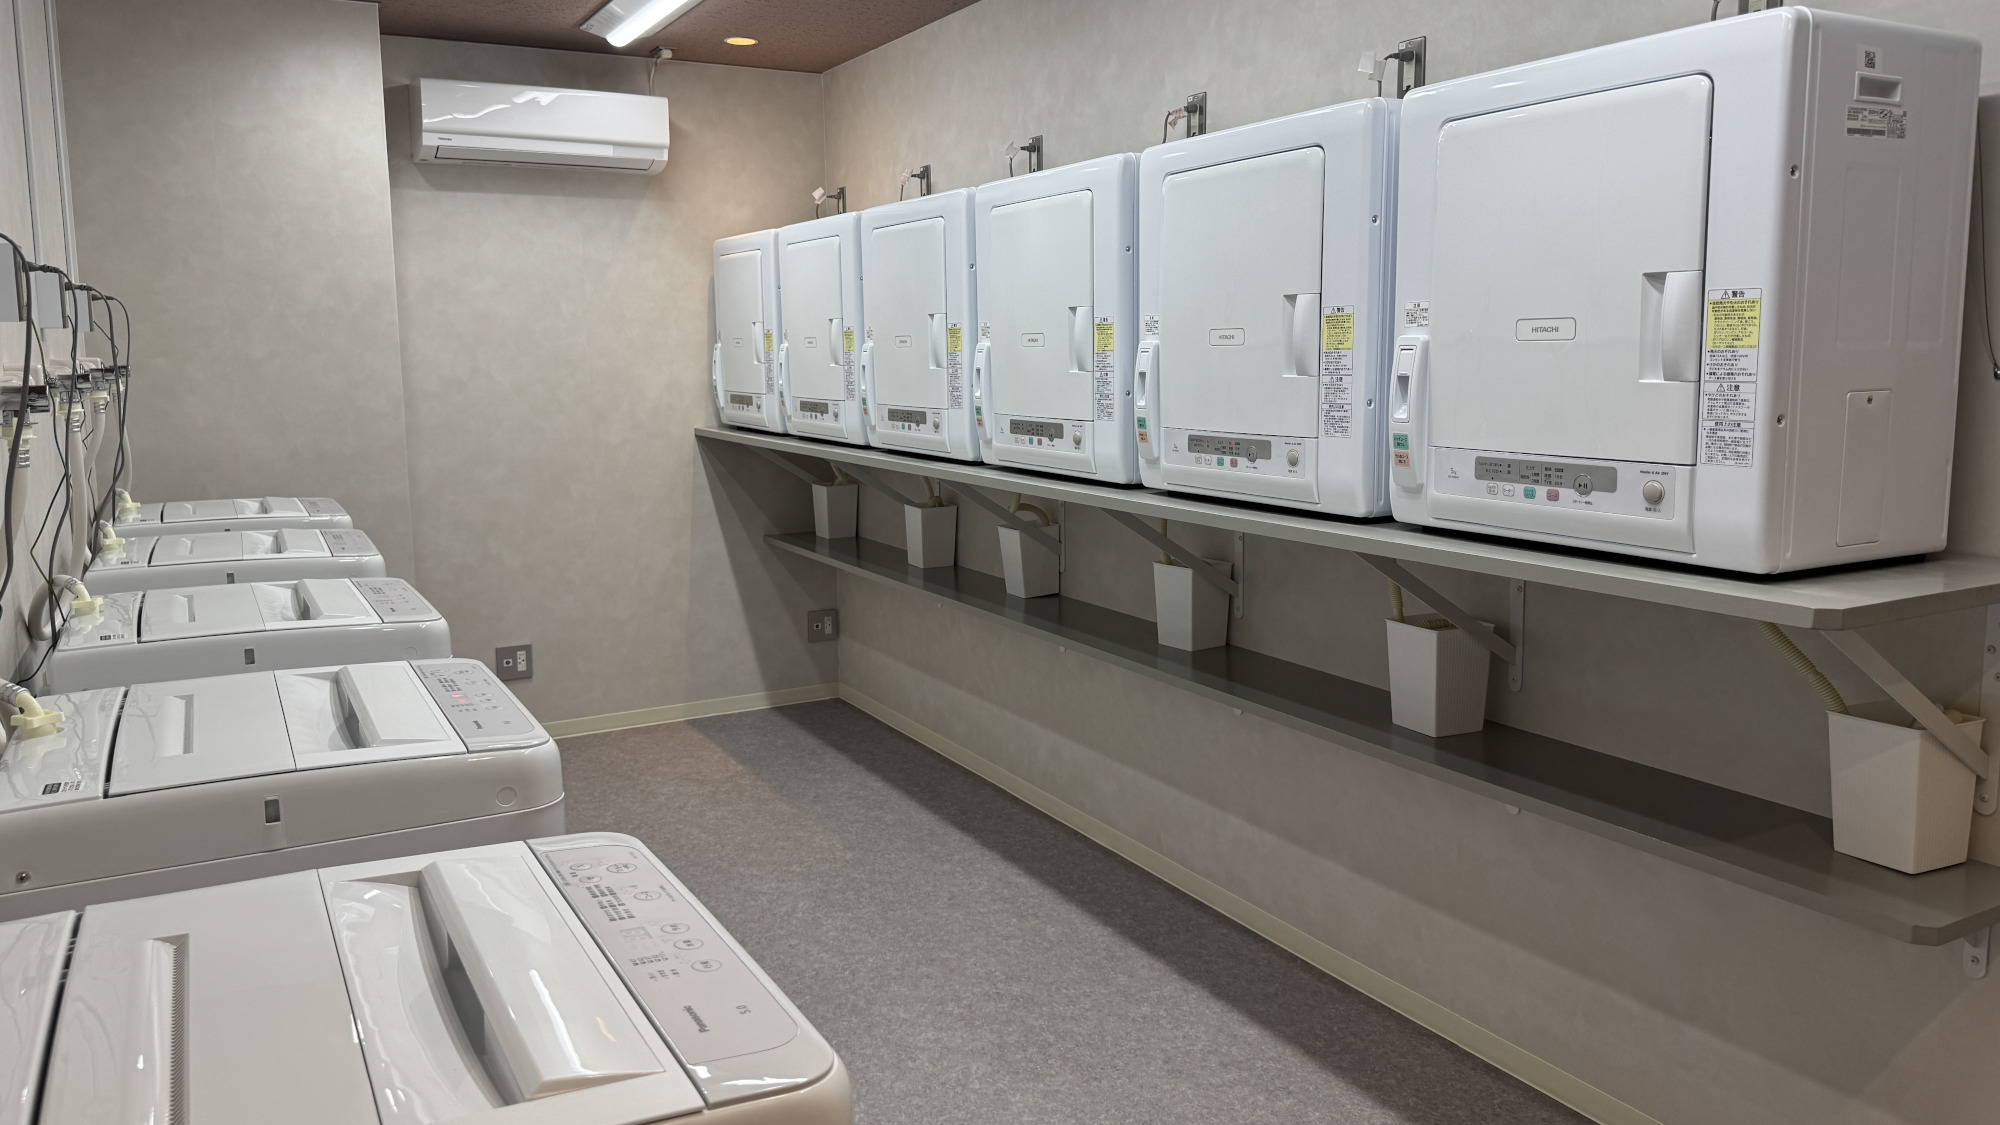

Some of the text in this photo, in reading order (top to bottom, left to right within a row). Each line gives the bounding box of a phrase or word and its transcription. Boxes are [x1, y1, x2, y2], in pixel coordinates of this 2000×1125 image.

[1731, 290, 1746, 298] 警告
[1726, 384, 1740, 392] 注意
[682, 1005, 710, 1033] Panasonic
